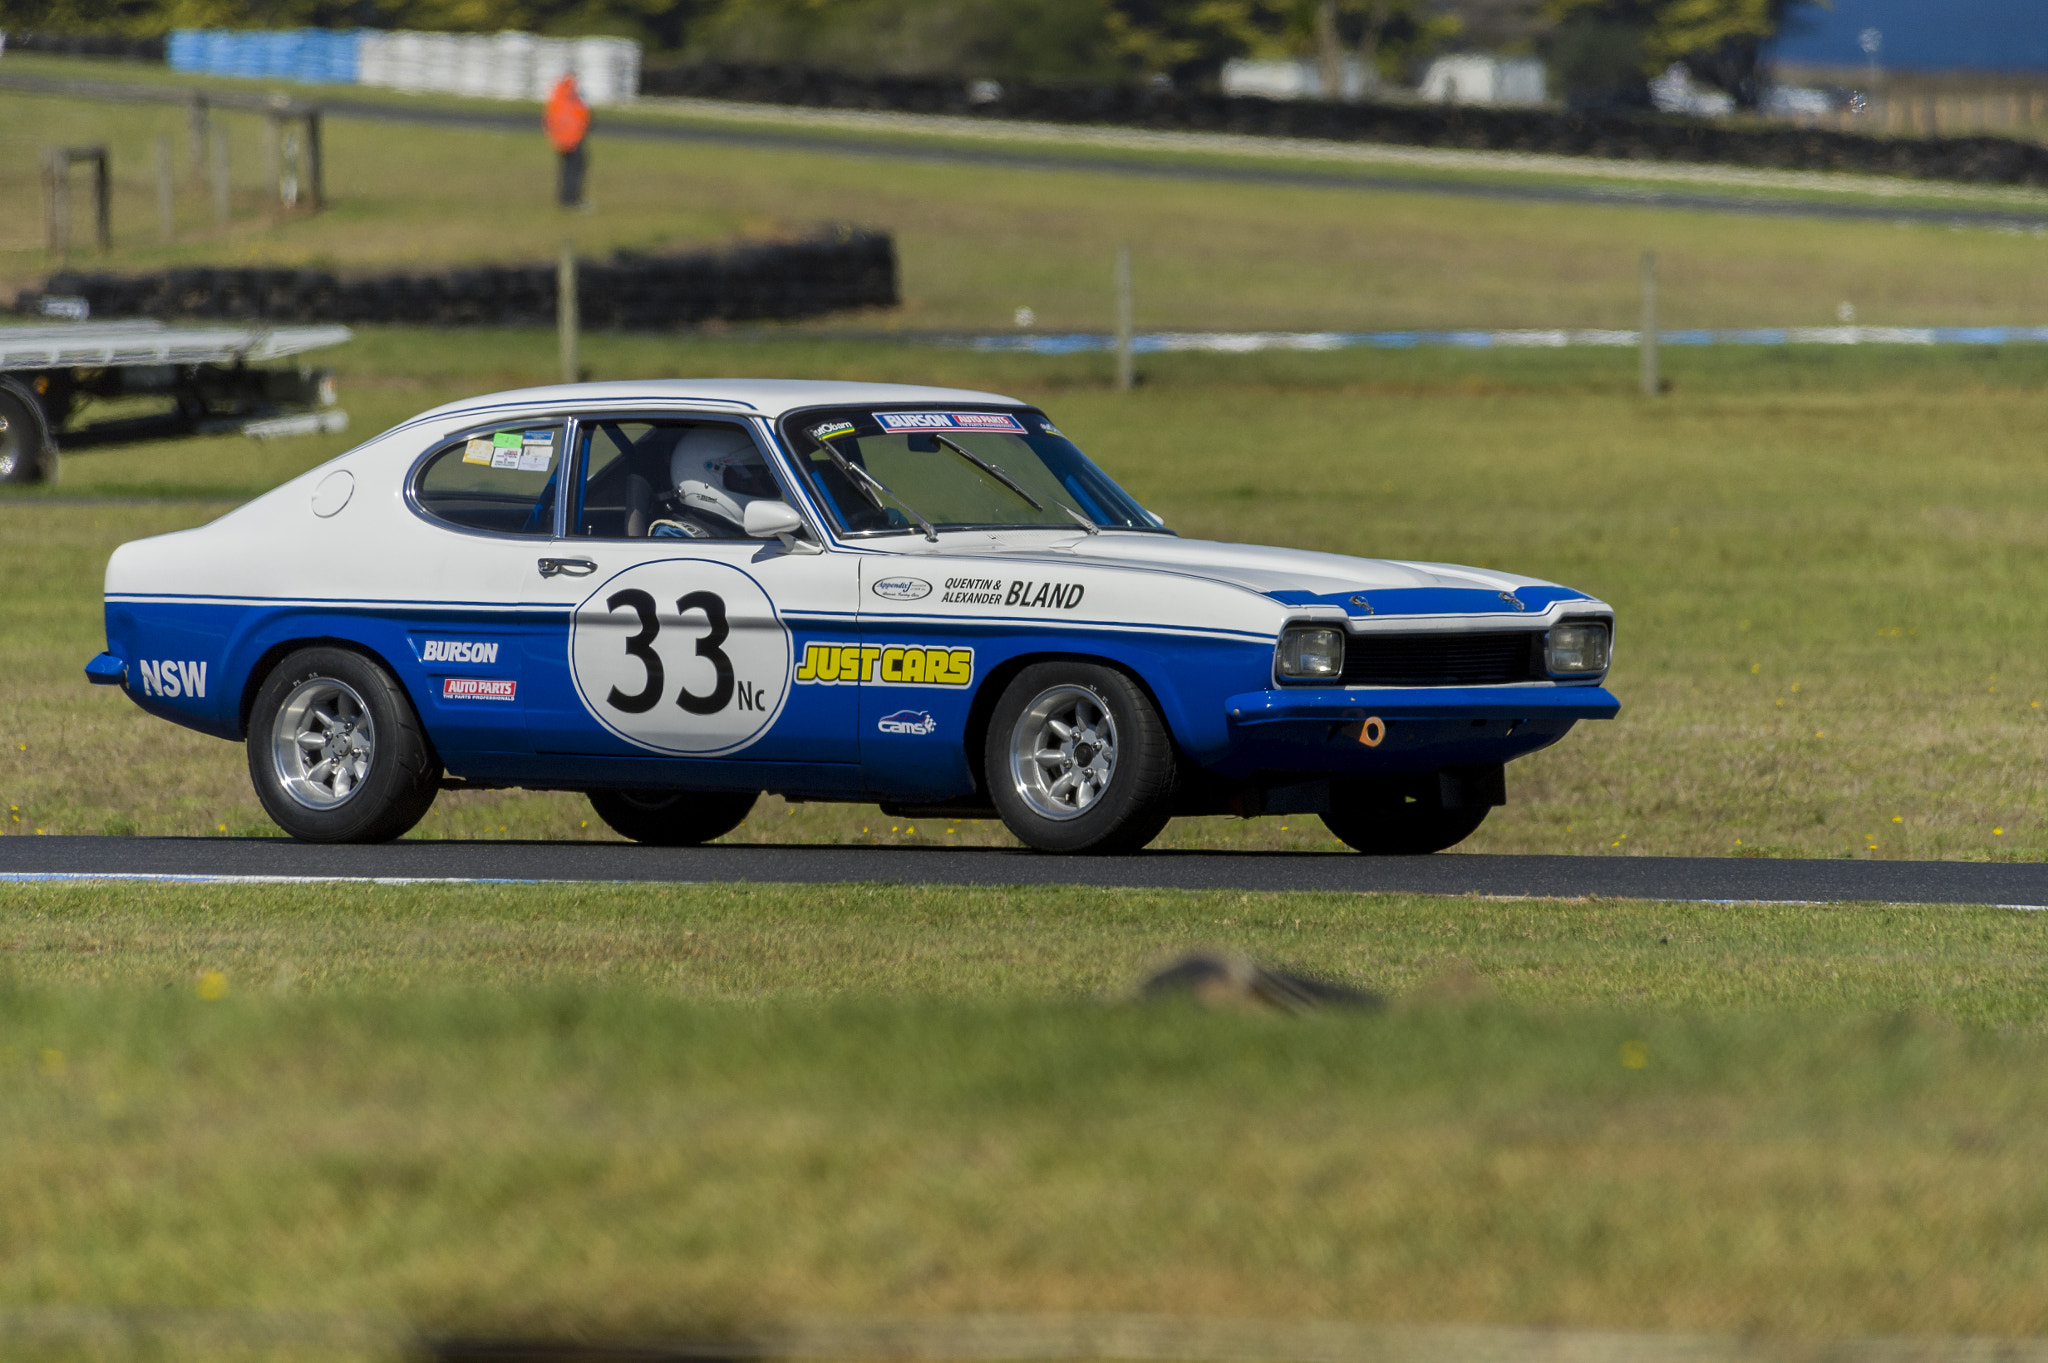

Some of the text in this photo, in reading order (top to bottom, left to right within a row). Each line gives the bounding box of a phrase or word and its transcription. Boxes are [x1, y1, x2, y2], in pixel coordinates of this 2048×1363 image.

[882, 414, 953, 427] BURSON
[958, 415, 1009, 424] AUTO PARTS
[944, 577, 1002, 590] QUENTIN &
[1004, 580, 1085, 609] BLAND
[941, 591, 1002, 605] ALEXANDER
[423, 640, 499, 663] BURSON
[606, 588, 735, 716] 33
[797, 645, 972, 686] JUST CARS
[140, 659, 207, 698] NSW
[448, 680, 512, 695] AUTO PARTS
[737, 680, 766, 712] Nc
